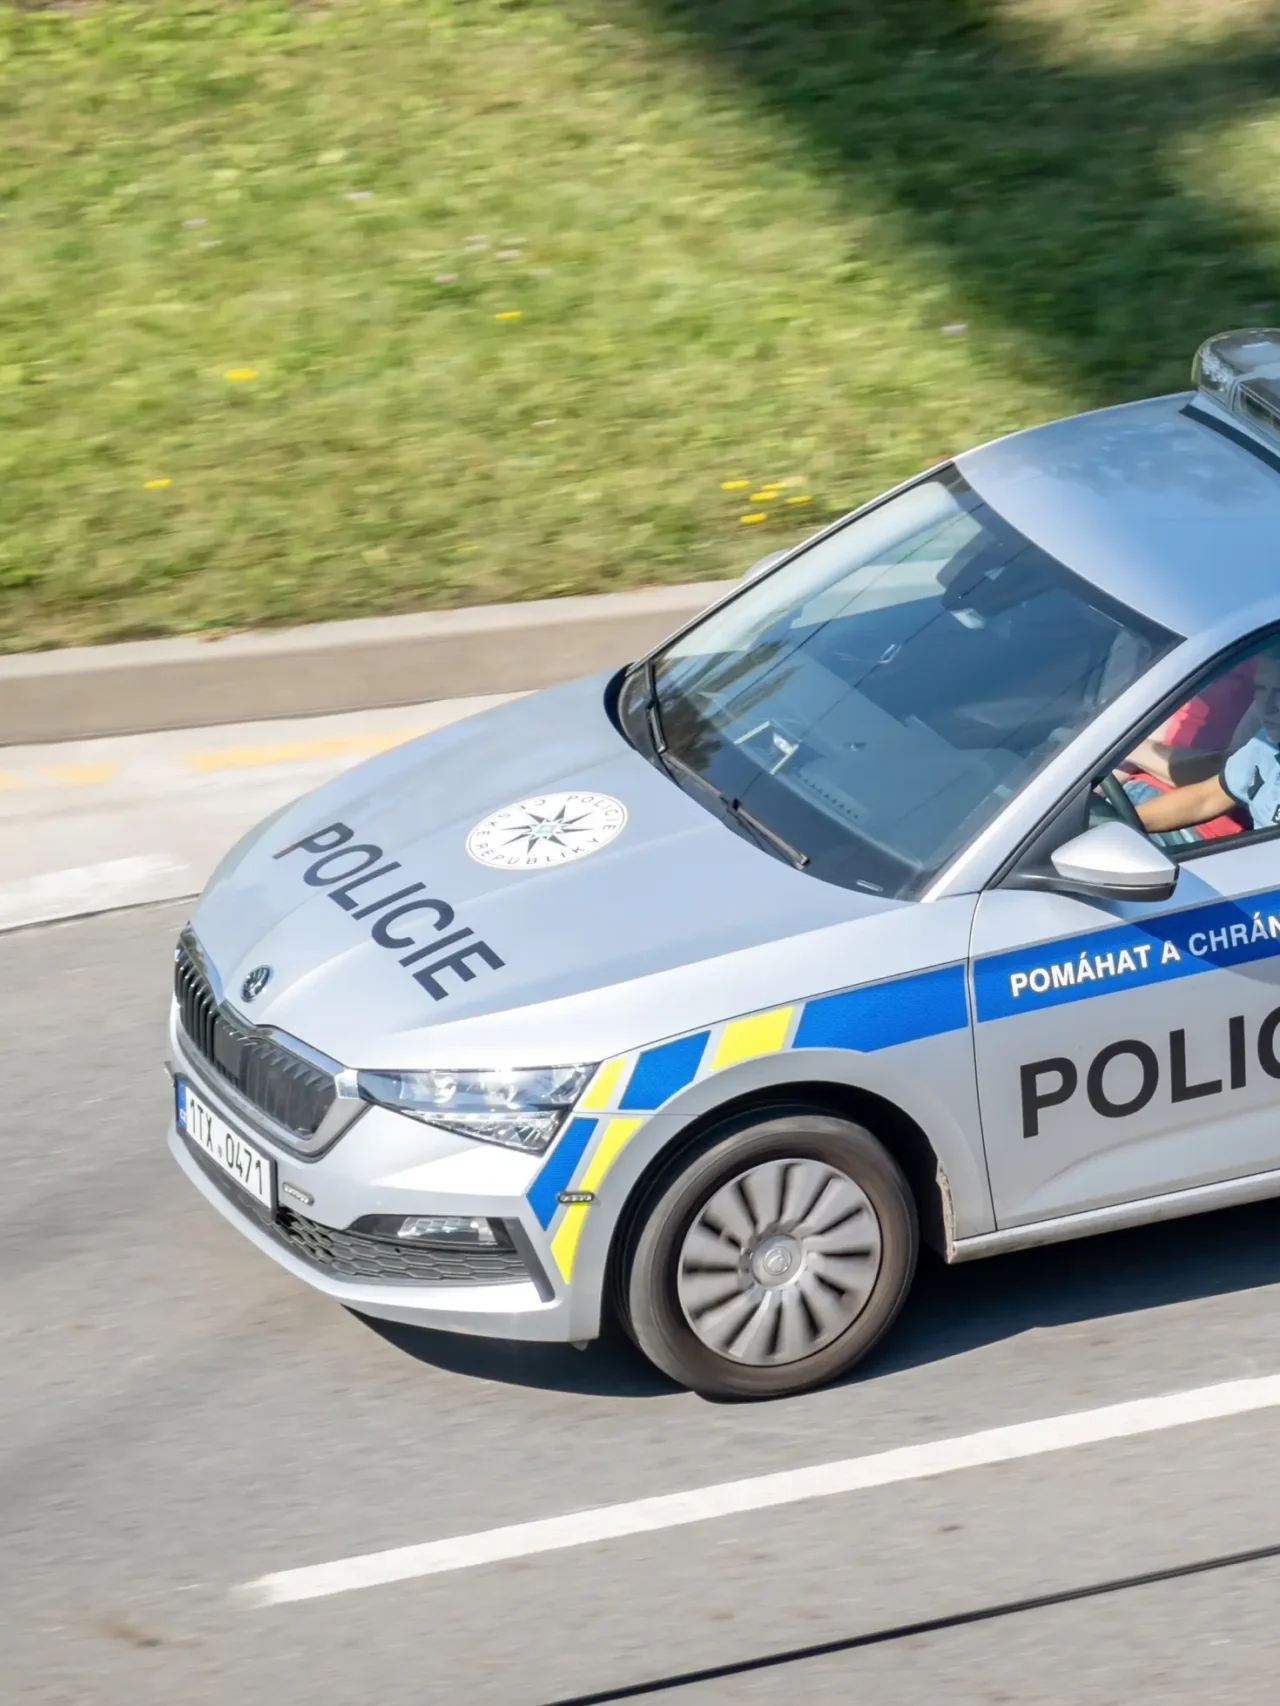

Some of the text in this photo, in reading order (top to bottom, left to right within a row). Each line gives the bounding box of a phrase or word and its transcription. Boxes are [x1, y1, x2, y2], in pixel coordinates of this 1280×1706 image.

[566, 794, 620, 831] POLICIE
[271, 821, 506, 1002] POLICIE
[1010, 944, 1151, 998] POMÁHAT
[1161, 940, 1181, 964] A
